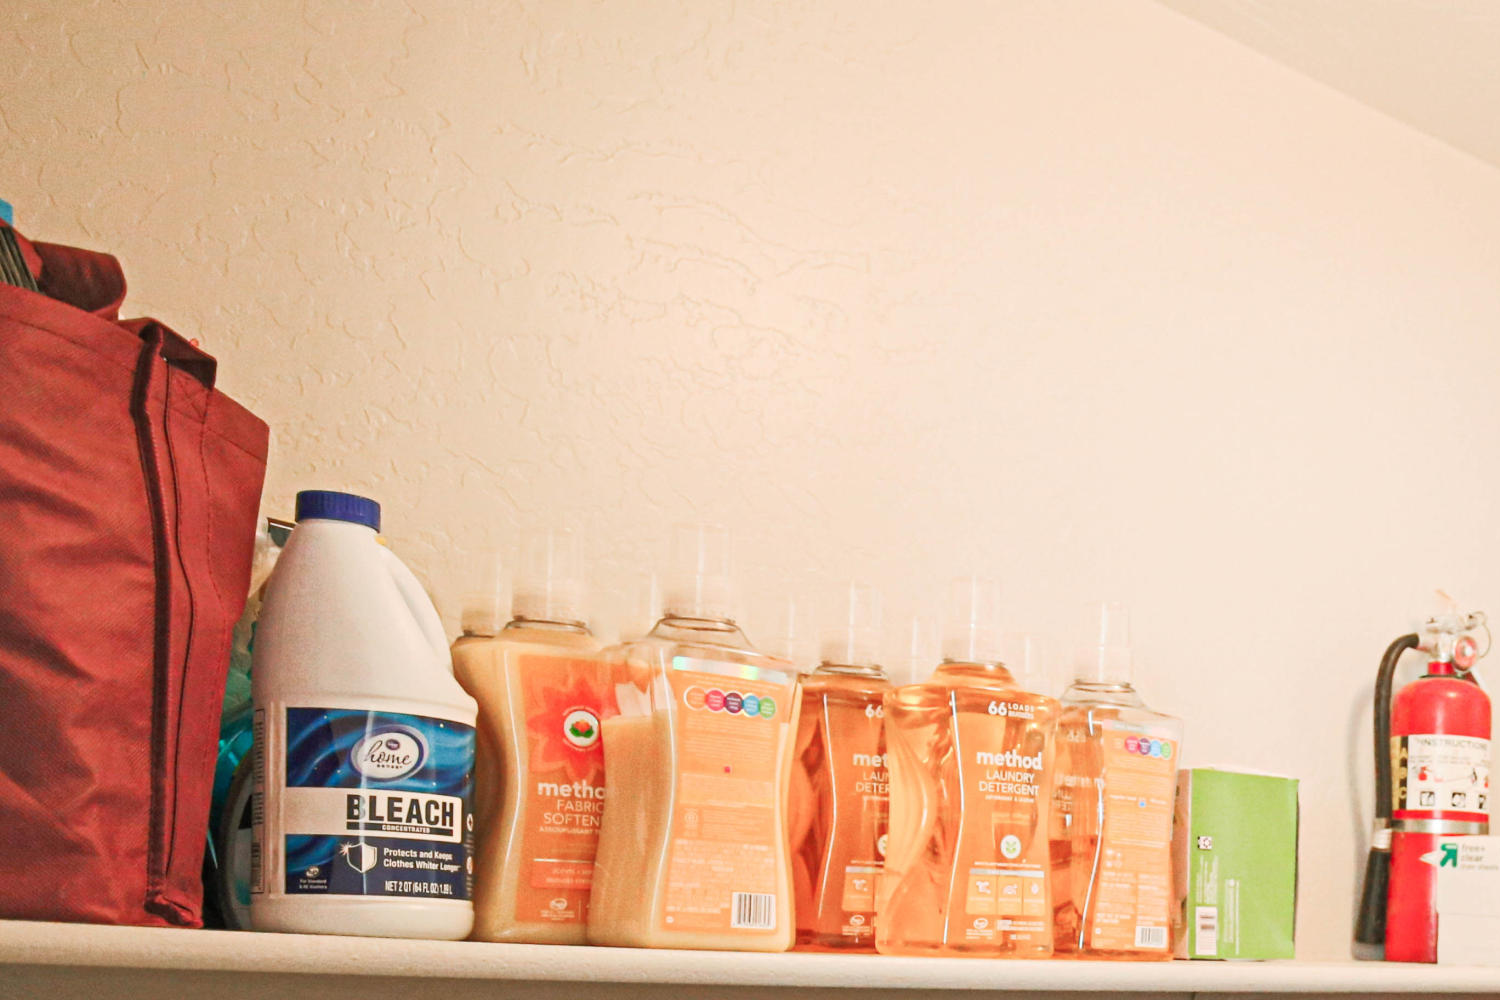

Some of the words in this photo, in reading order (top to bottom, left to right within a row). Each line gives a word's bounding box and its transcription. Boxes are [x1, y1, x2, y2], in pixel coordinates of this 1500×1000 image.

[865, 704, 884, 718] 66
[988, 701, 1007, 716] 66
[977, 749, 1043, 770] method
[986, 769, 1035, 783] LAUNDRY
[978, 781, 1040, 796] DETERGENT
[347, 794, 454, 827] BLEACH
[557, 800, 604, 813] FABRIC
[543, 812, 600, 827] SOFTEN
[382, 824, 431, 834] CONCENTRATED
[384, 847, 417, 858] Protects
[420, 849, 433, 858] and
[434, 850, 453, 861] Keeps
[384, 858, 414, 869] Clothes
[416, 861, 439, 870] Whiter
[385, 880, 397, 892] NET
[399, 881, 403, 892] 2
[404, 882, 412, 893] QT
[413, 881, 422, 894] (64
[423, 882, 429, 893] FL
[430, 882, 439, 894] OZ)
